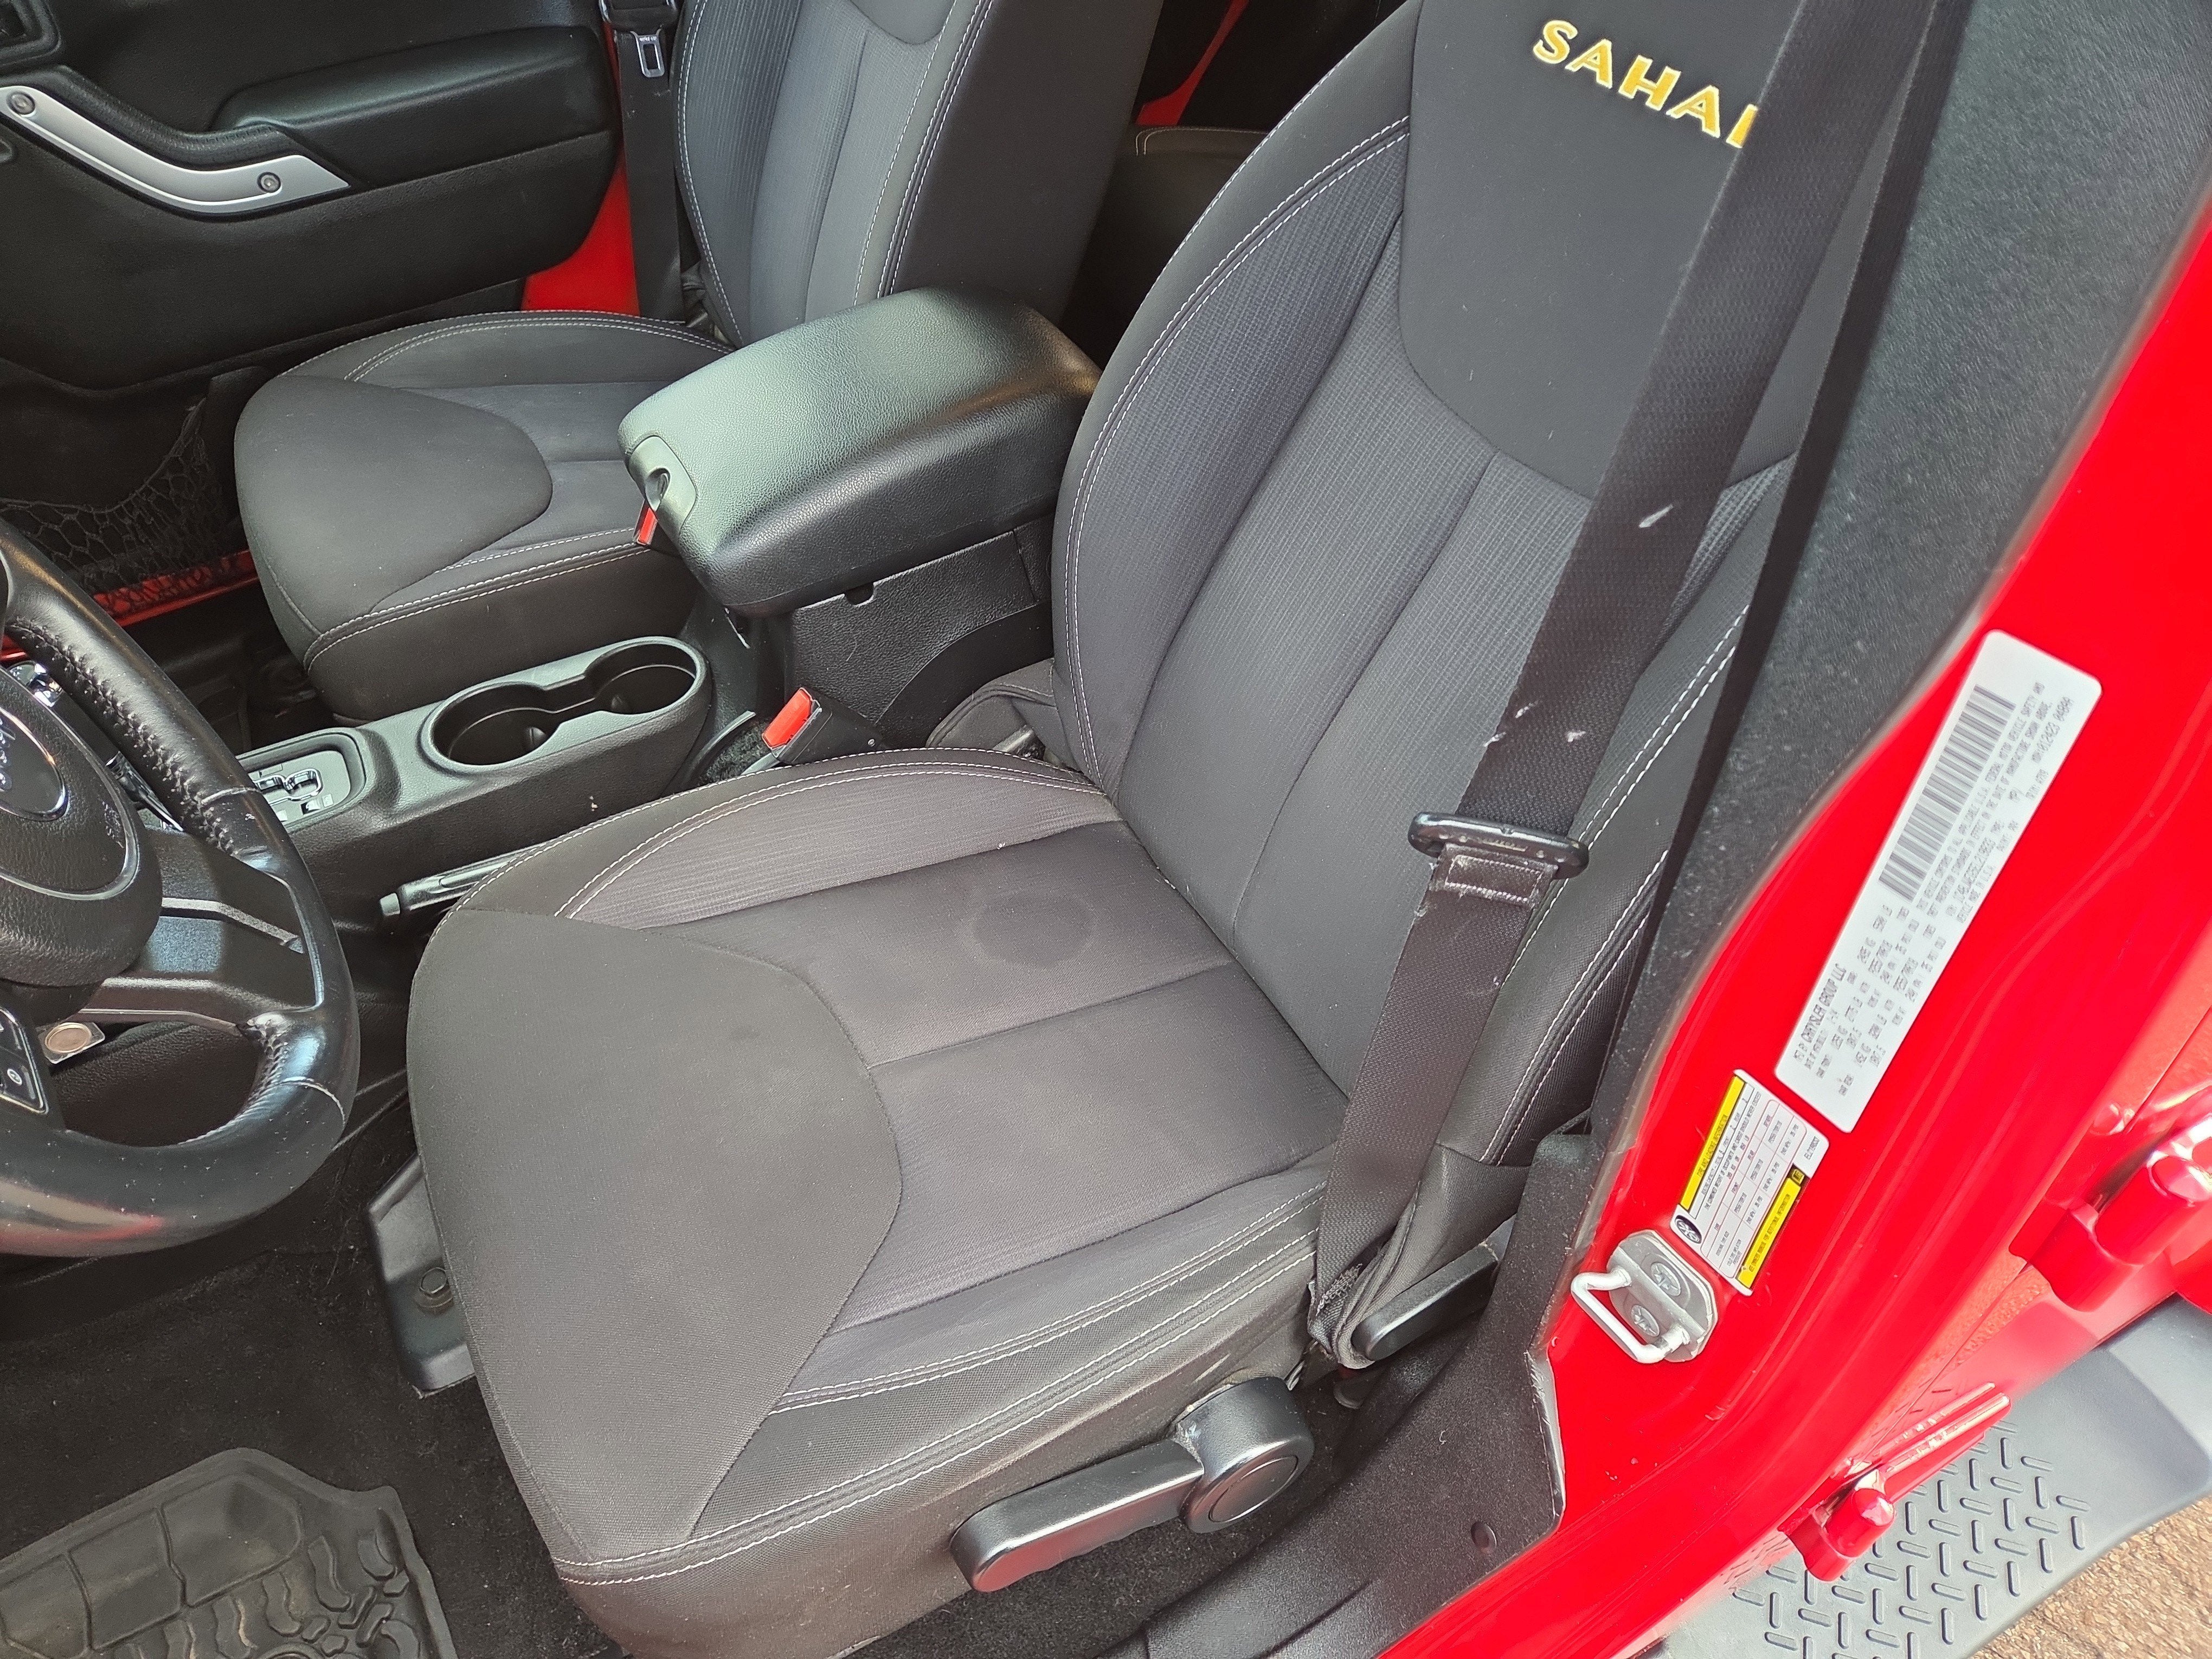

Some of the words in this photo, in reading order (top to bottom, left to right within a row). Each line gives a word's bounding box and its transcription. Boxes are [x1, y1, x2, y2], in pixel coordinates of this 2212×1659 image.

[1800, 1003, 1827, 1044] CHRYSLER
[1818, 978, 1840, 1007] GROUP
[1830, 962, 1847, 982] LLC
